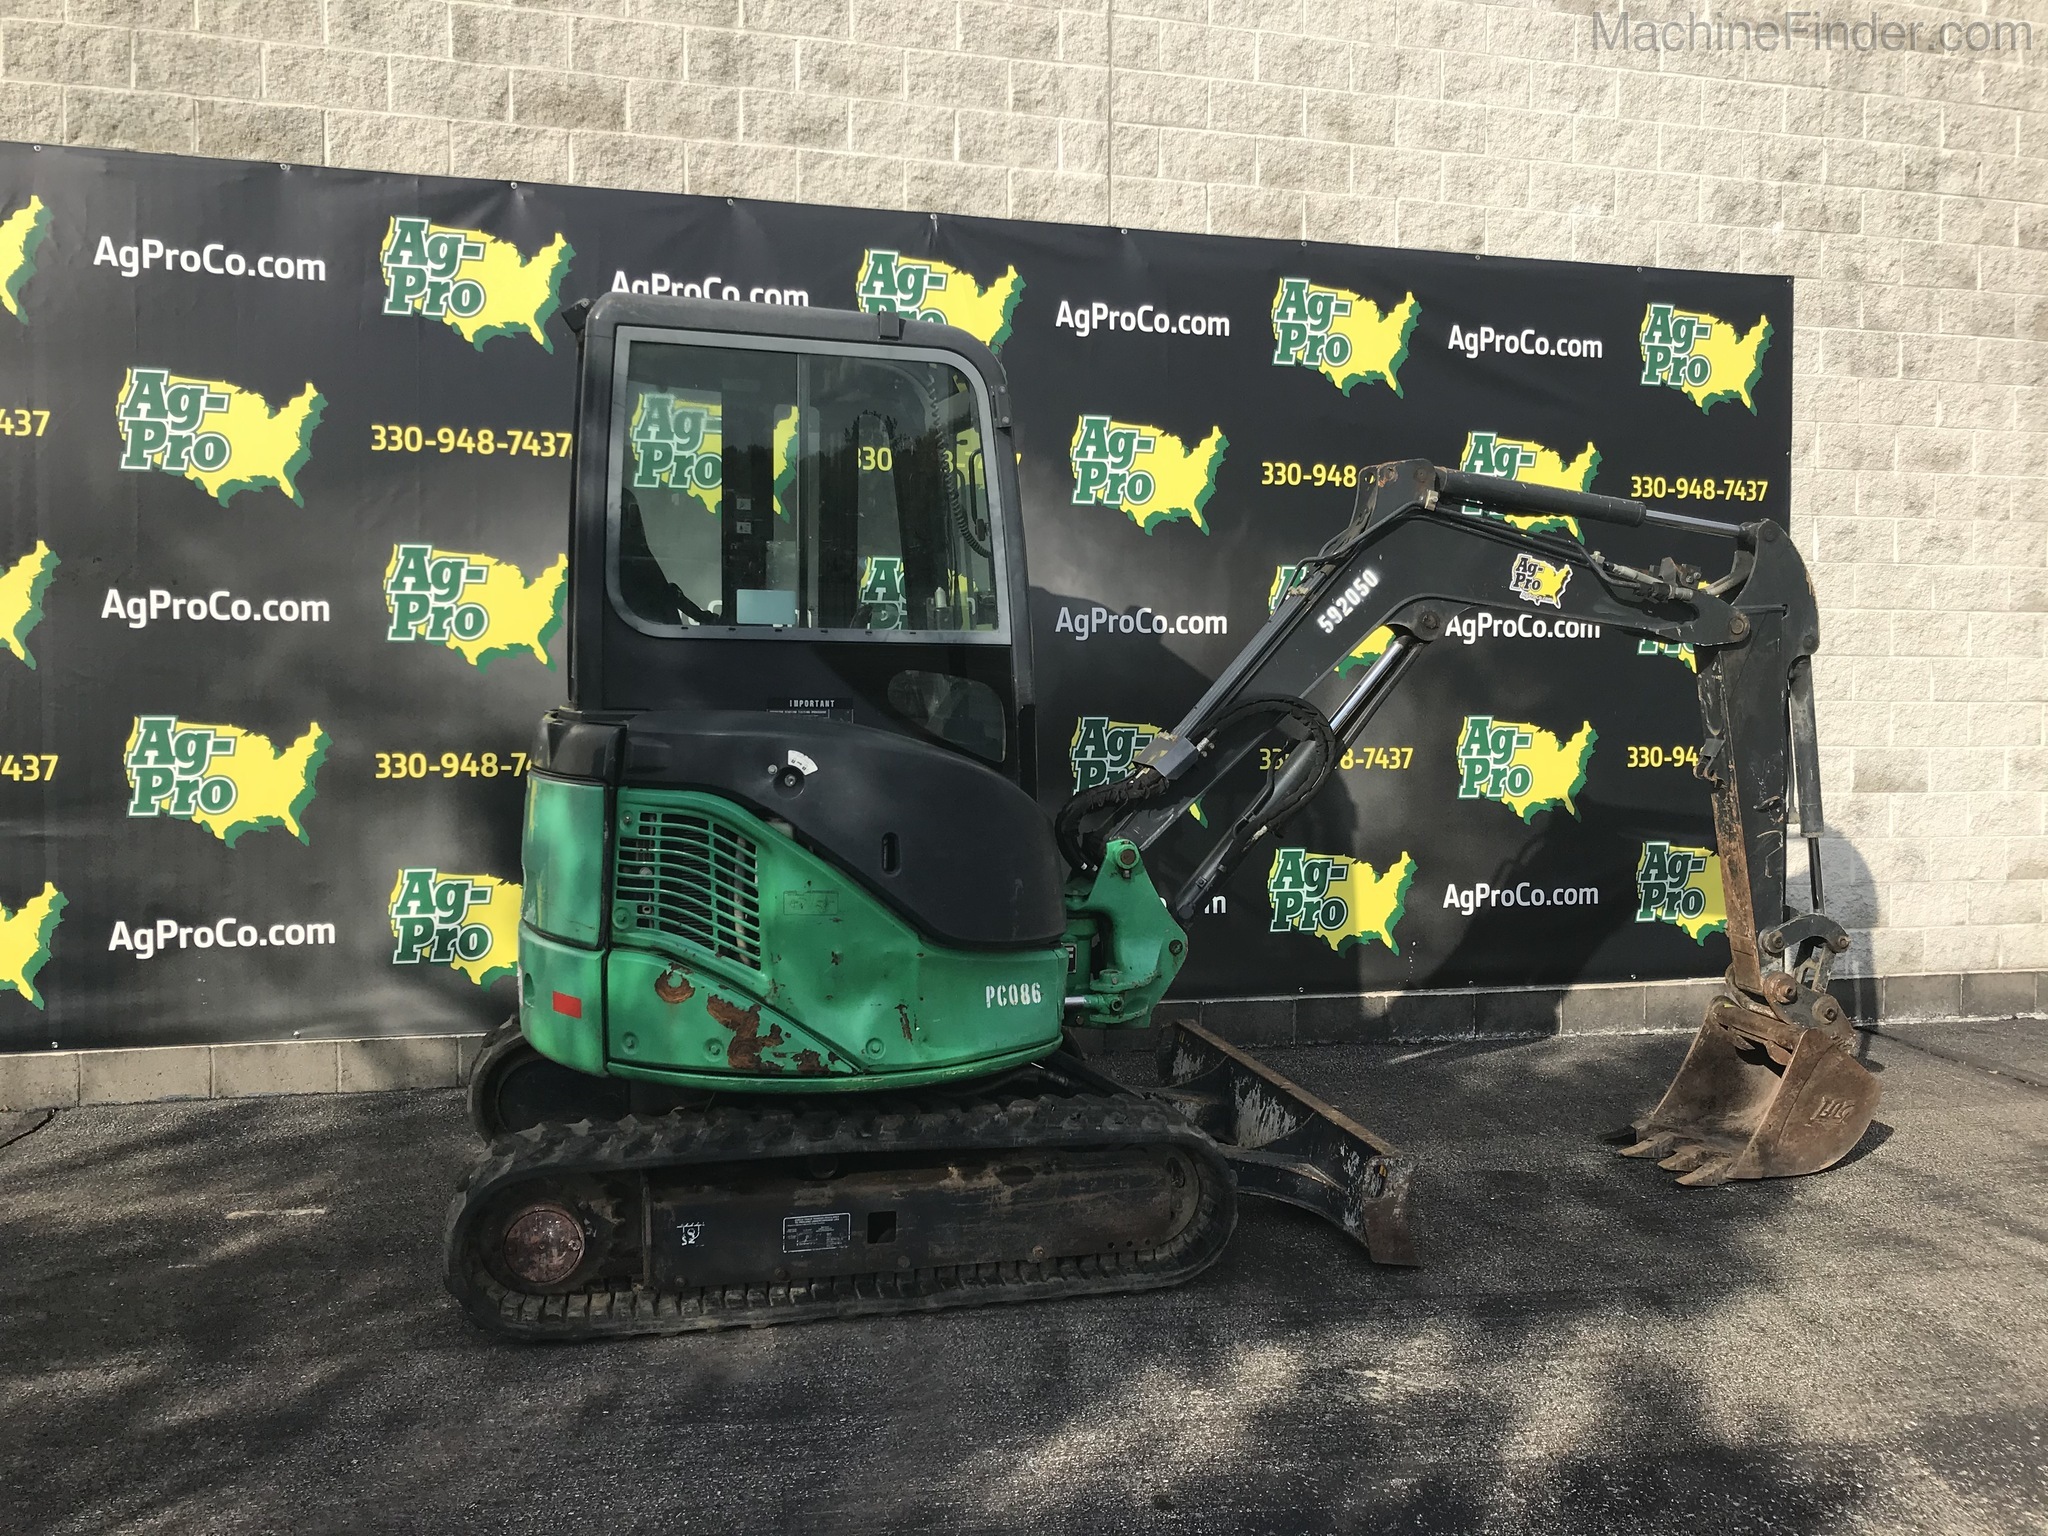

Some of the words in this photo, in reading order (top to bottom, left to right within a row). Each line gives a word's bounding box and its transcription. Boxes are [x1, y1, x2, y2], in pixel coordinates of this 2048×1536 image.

[93, 235, 326, 281] AgProCo.com
[383, 217, 484, 279] Ag-
[383, 266, 484, 317] Pro
[859, 250, 947, 308] Ag-
[1055, 301, 1230, 338] AgProCo.com
[1273, 278, 1351, 333] Ag-
[1641, 303, 1710, 354] Ag-
[1273, 321, 1351, 366] Pro
[1448, 325, 1603, 359] AgProCo.com
[1641, 343, 1710, 386] Pro
[119, 368, 229, 432] Ag-
[119, 418, 229, 471] Pro
[371, 424, 572, 457] 330-948-7437
[633, 439, 722, 488] Pro
[1073, 415, 1154, 470] Ag-
[1463, 431, 1536, 480] Ag-
[1073, 458, 1154, 504] Pro
[1630, 475, 1769, 502] 330-948-7437
[387, 544, 489, 604] Ag-
[1513, 572, 1541, 590] Pro
[1516, 557, 1543, 577] Ag-
[101, 589, 330, 628] AgProCo.com
[387, 591, 489, 641] Pro
[1055, 606, 1228, 640] AgProCo.com
[1316, 569, 1380, 634] 592050
[1445, 612, 1601, 645] AgProCo.com
[789, 699, 835, 708] IMPORTANT
[128, 716, 236, 778] Ag-
[1458, 716, 1532, 767] Ag-
[0, 755, 59, 781] 437
[375, 752, 532, 779] 330-948-7
[1458, 756, 1532, 798] Pro
[128, 764, 236, 816] Pro
[1270, 849, 1347, 900] Ag-
[1637, 842, 1705, 891] Ag-
[393, 867, 492, 927] Ag-
[1270, 889, 1347, 932] Pro
[1443, 882, 1599, 916] AgProCo.com
[1637, 880, 1705, 921] Pro
[109, 918, 335, 959] AgProCo.com
[393, 914, 492, 964] Pro
[985, 982, 1042, 1009] PC086
